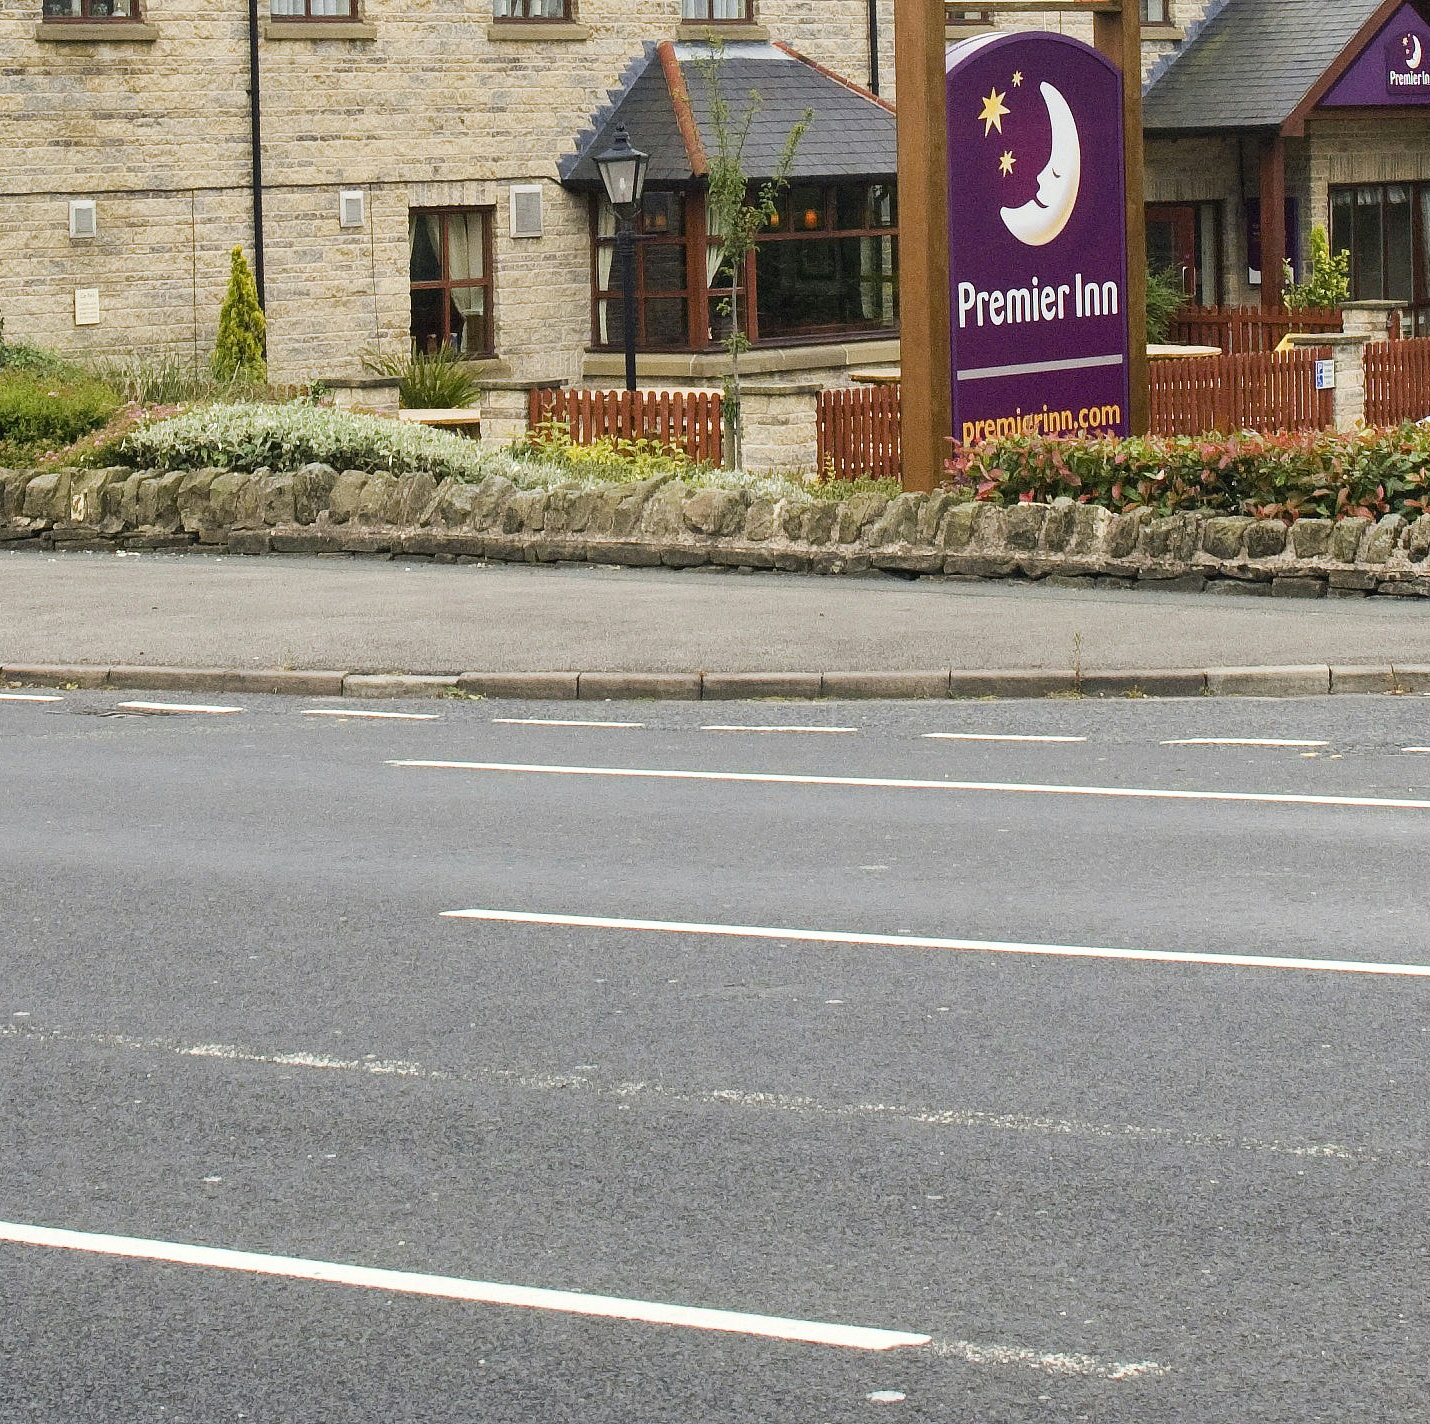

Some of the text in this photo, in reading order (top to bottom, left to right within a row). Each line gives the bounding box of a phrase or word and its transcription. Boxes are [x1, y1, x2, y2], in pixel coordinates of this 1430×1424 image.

[1389, 70, 1421, 86] Premier
[958, 273, 1119, 329] Premier Inn
